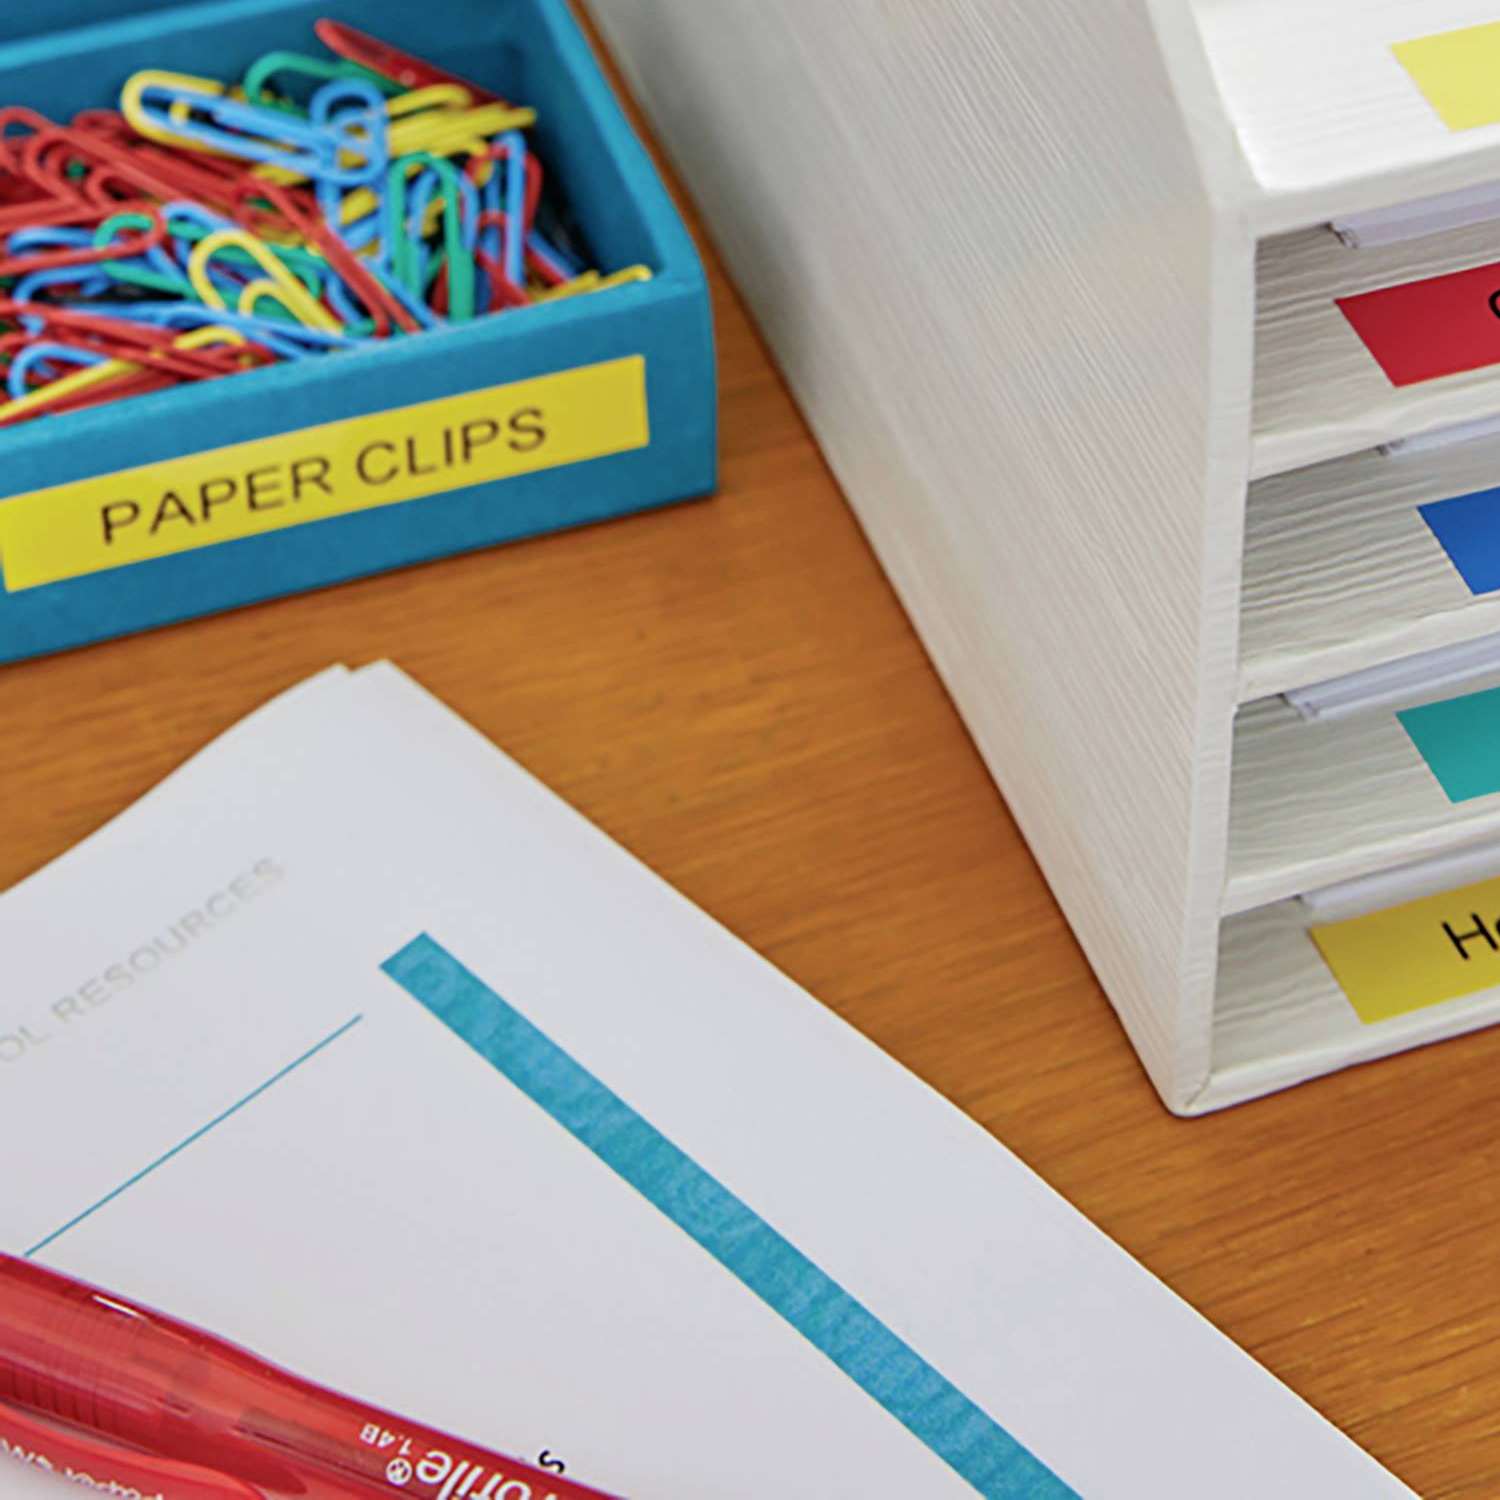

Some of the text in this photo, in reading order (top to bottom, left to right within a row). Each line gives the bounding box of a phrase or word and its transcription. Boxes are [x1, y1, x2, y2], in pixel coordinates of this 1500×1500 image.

[100, 407, 547, 545] PAPER CLIPS
[51, 857, 284, 1024] RESOURCES
